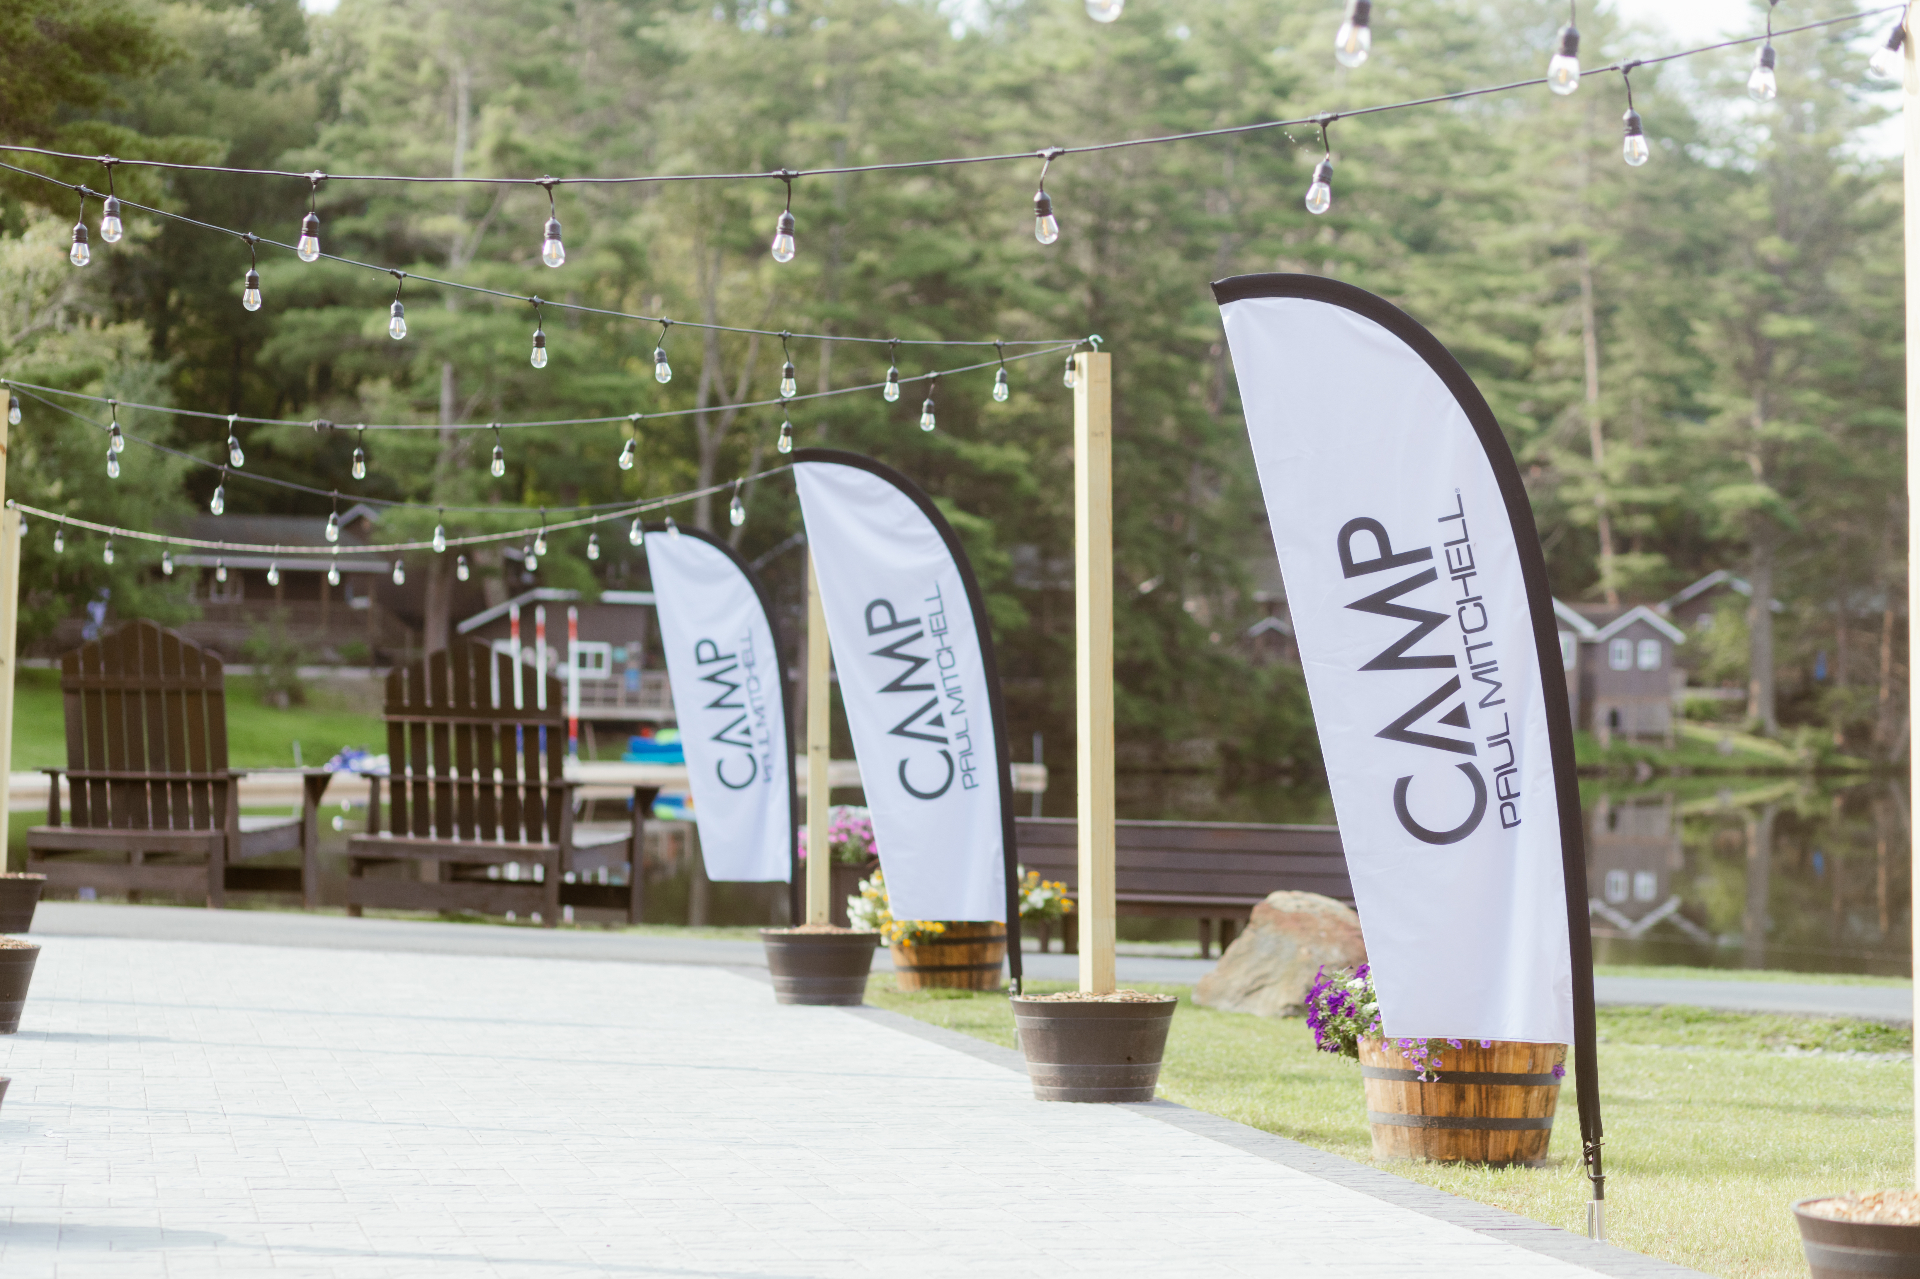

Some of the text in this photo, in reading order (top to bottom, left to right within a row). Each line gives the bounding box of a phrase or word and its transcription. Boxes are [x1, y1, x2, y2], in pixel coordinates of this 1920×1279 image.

[695, 637, 757, 790] CAMP
[864, 597, 955, 801] CAMP
[924, 580, 979, 790] PAUL MITCHELL
[1337, 516, 1488, 845] CAMP
[1438, 493, 1522, 829] PAUL MITCHELL
